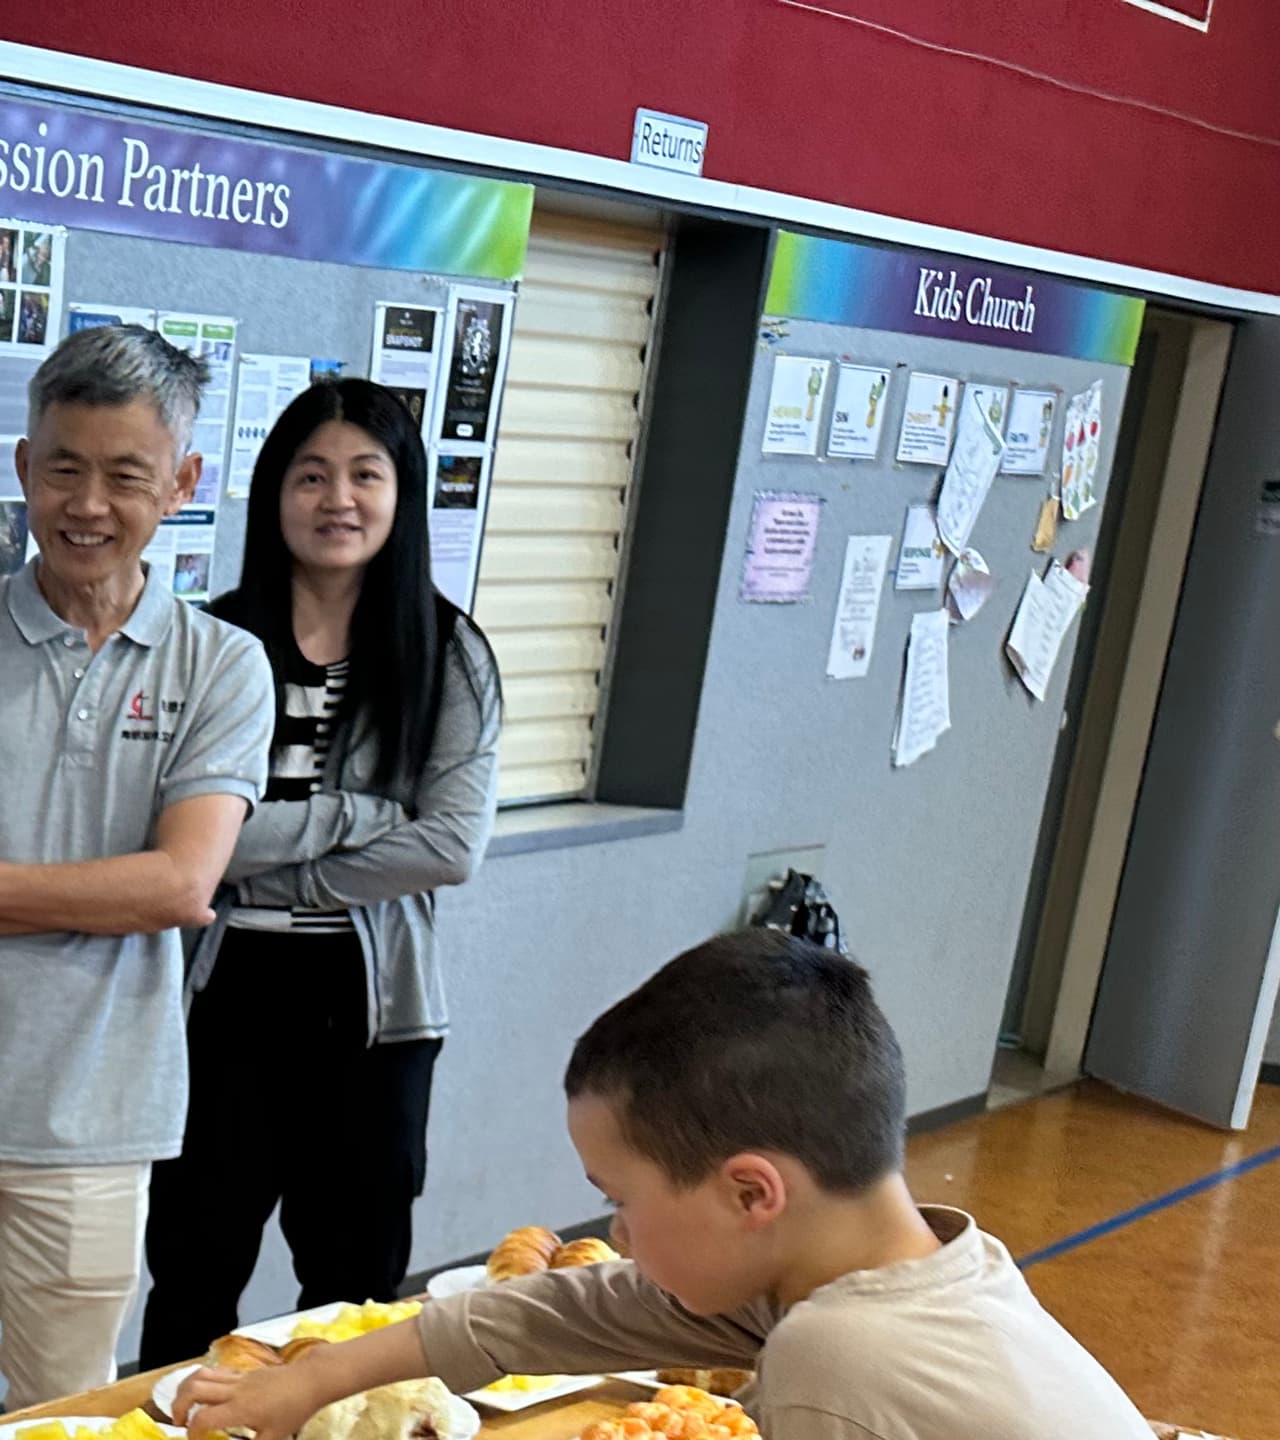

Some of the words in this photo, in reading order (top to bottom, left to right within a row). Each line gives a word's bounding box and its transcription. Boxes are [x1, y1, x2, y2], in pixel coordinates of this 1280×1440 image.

[640, 121, 703, 165] Returns
[117, 137, 291, 229] Partners
[914, 267, 963, 321] Kids
[965, 277, 1037, 334] Church
